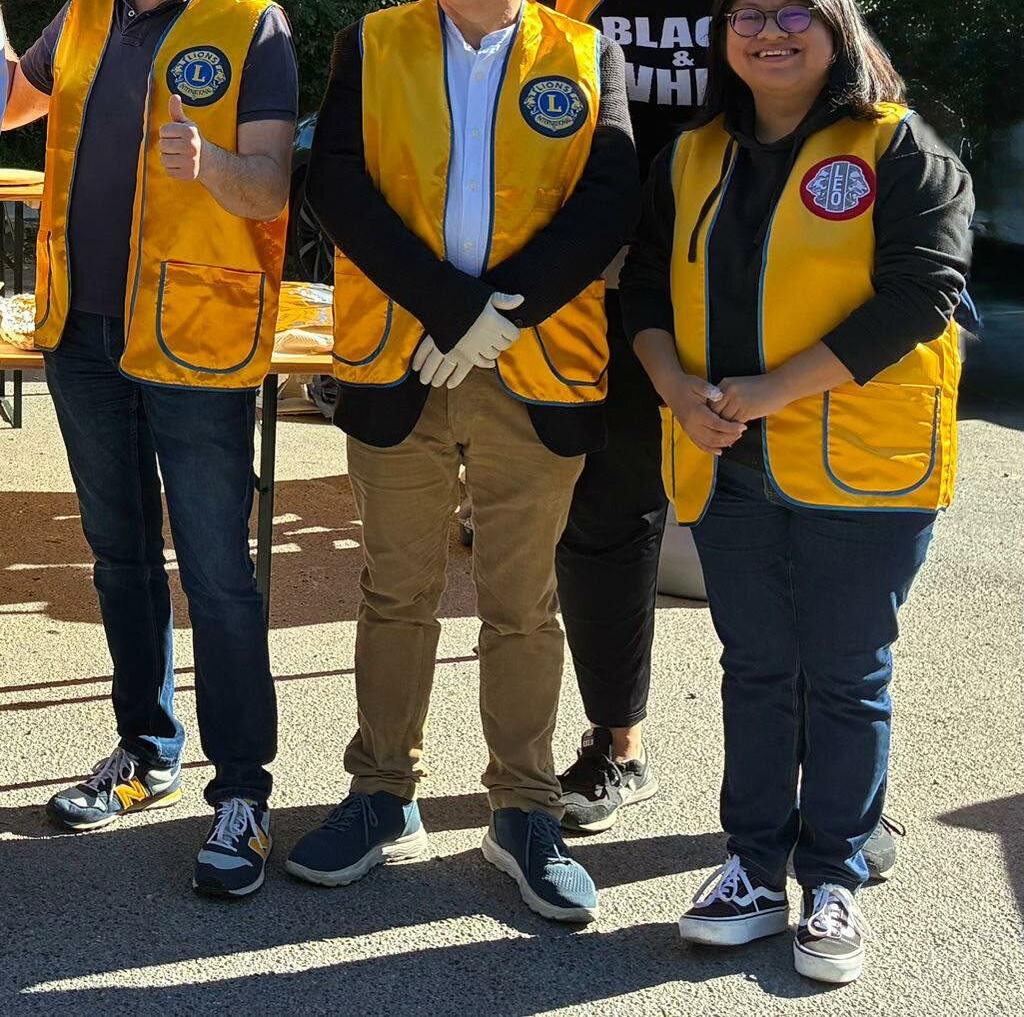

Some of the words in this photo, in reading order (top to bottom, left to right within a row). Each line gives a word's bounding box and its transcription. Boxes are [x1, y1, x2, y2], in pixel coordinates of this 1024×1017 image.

[187, 51, 217, 63] LIONS
[672, 50, 694, 67] &
[192, 64, 206, 82] L
[536, 81, 570, 92] LIONS
[547, 94, 562, 113] L
[830, 164, 844, 206] LEO
